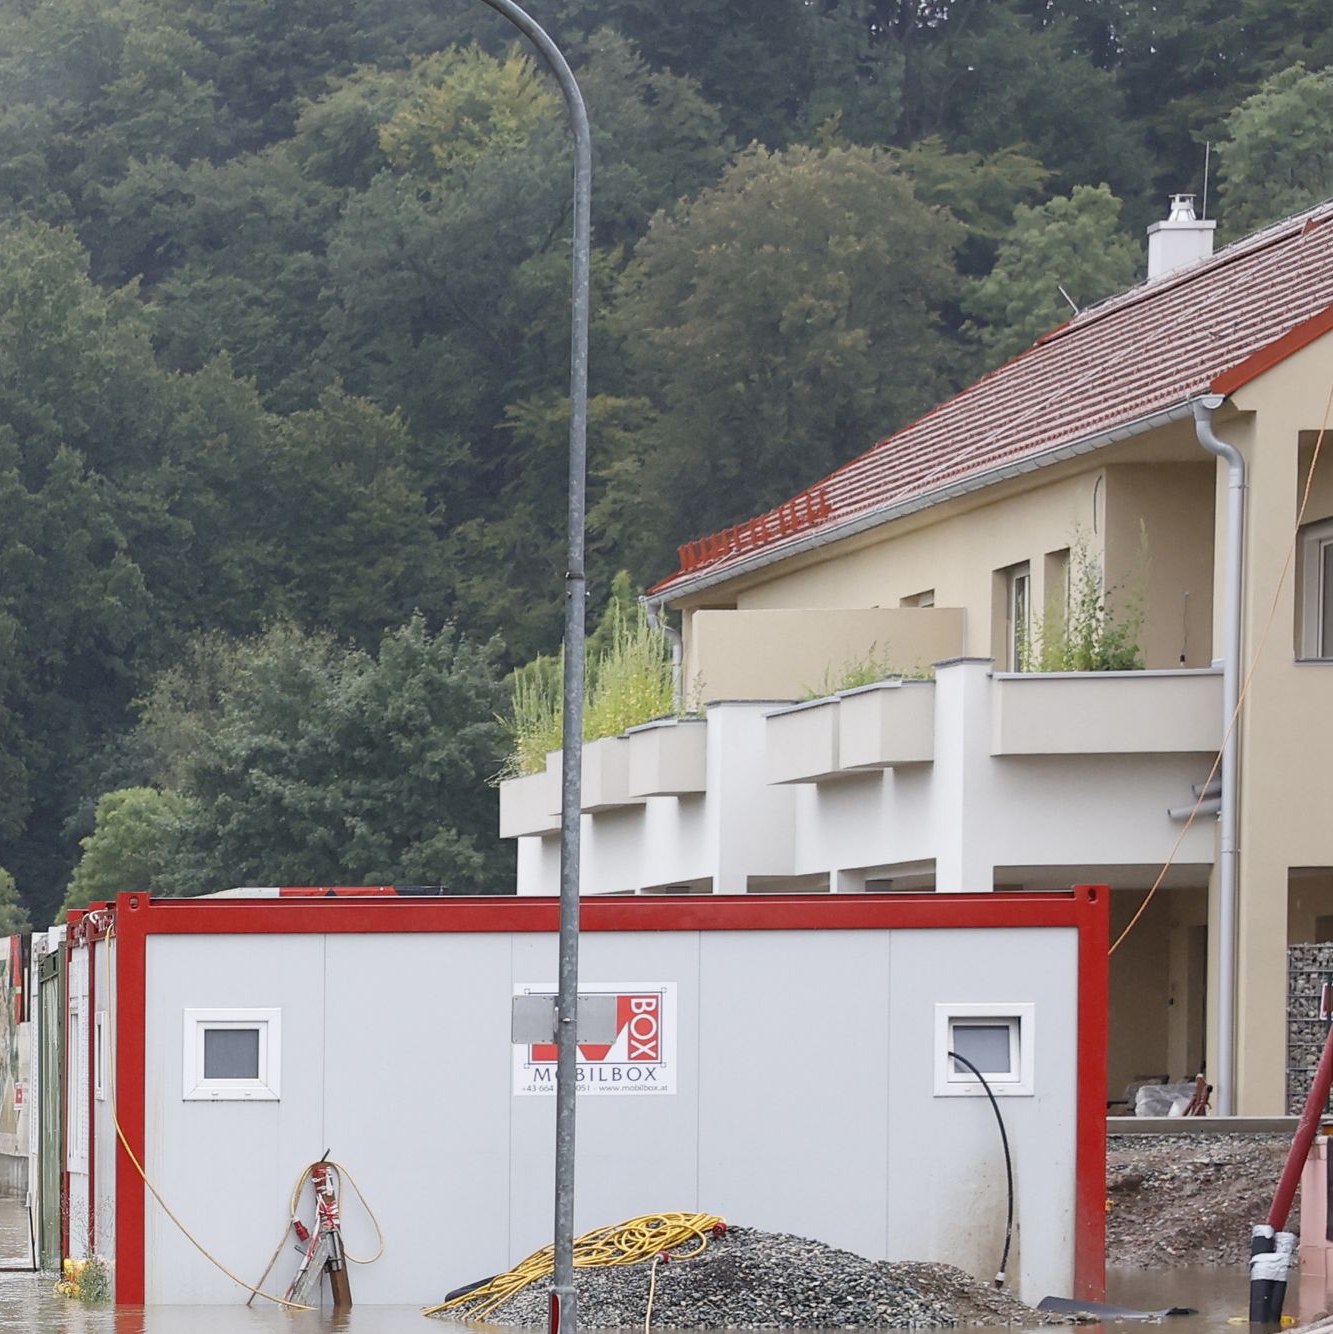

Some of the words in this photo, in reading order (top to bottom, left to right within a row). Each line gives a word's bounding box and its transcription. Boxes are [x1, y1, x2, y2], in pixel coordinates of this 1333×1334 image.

[630, 998, 657, 1058] BOX
[533, 1067, 657, 1082] MBILBOX
[598, 1084, 668, 1092] www.mobilbox.at
